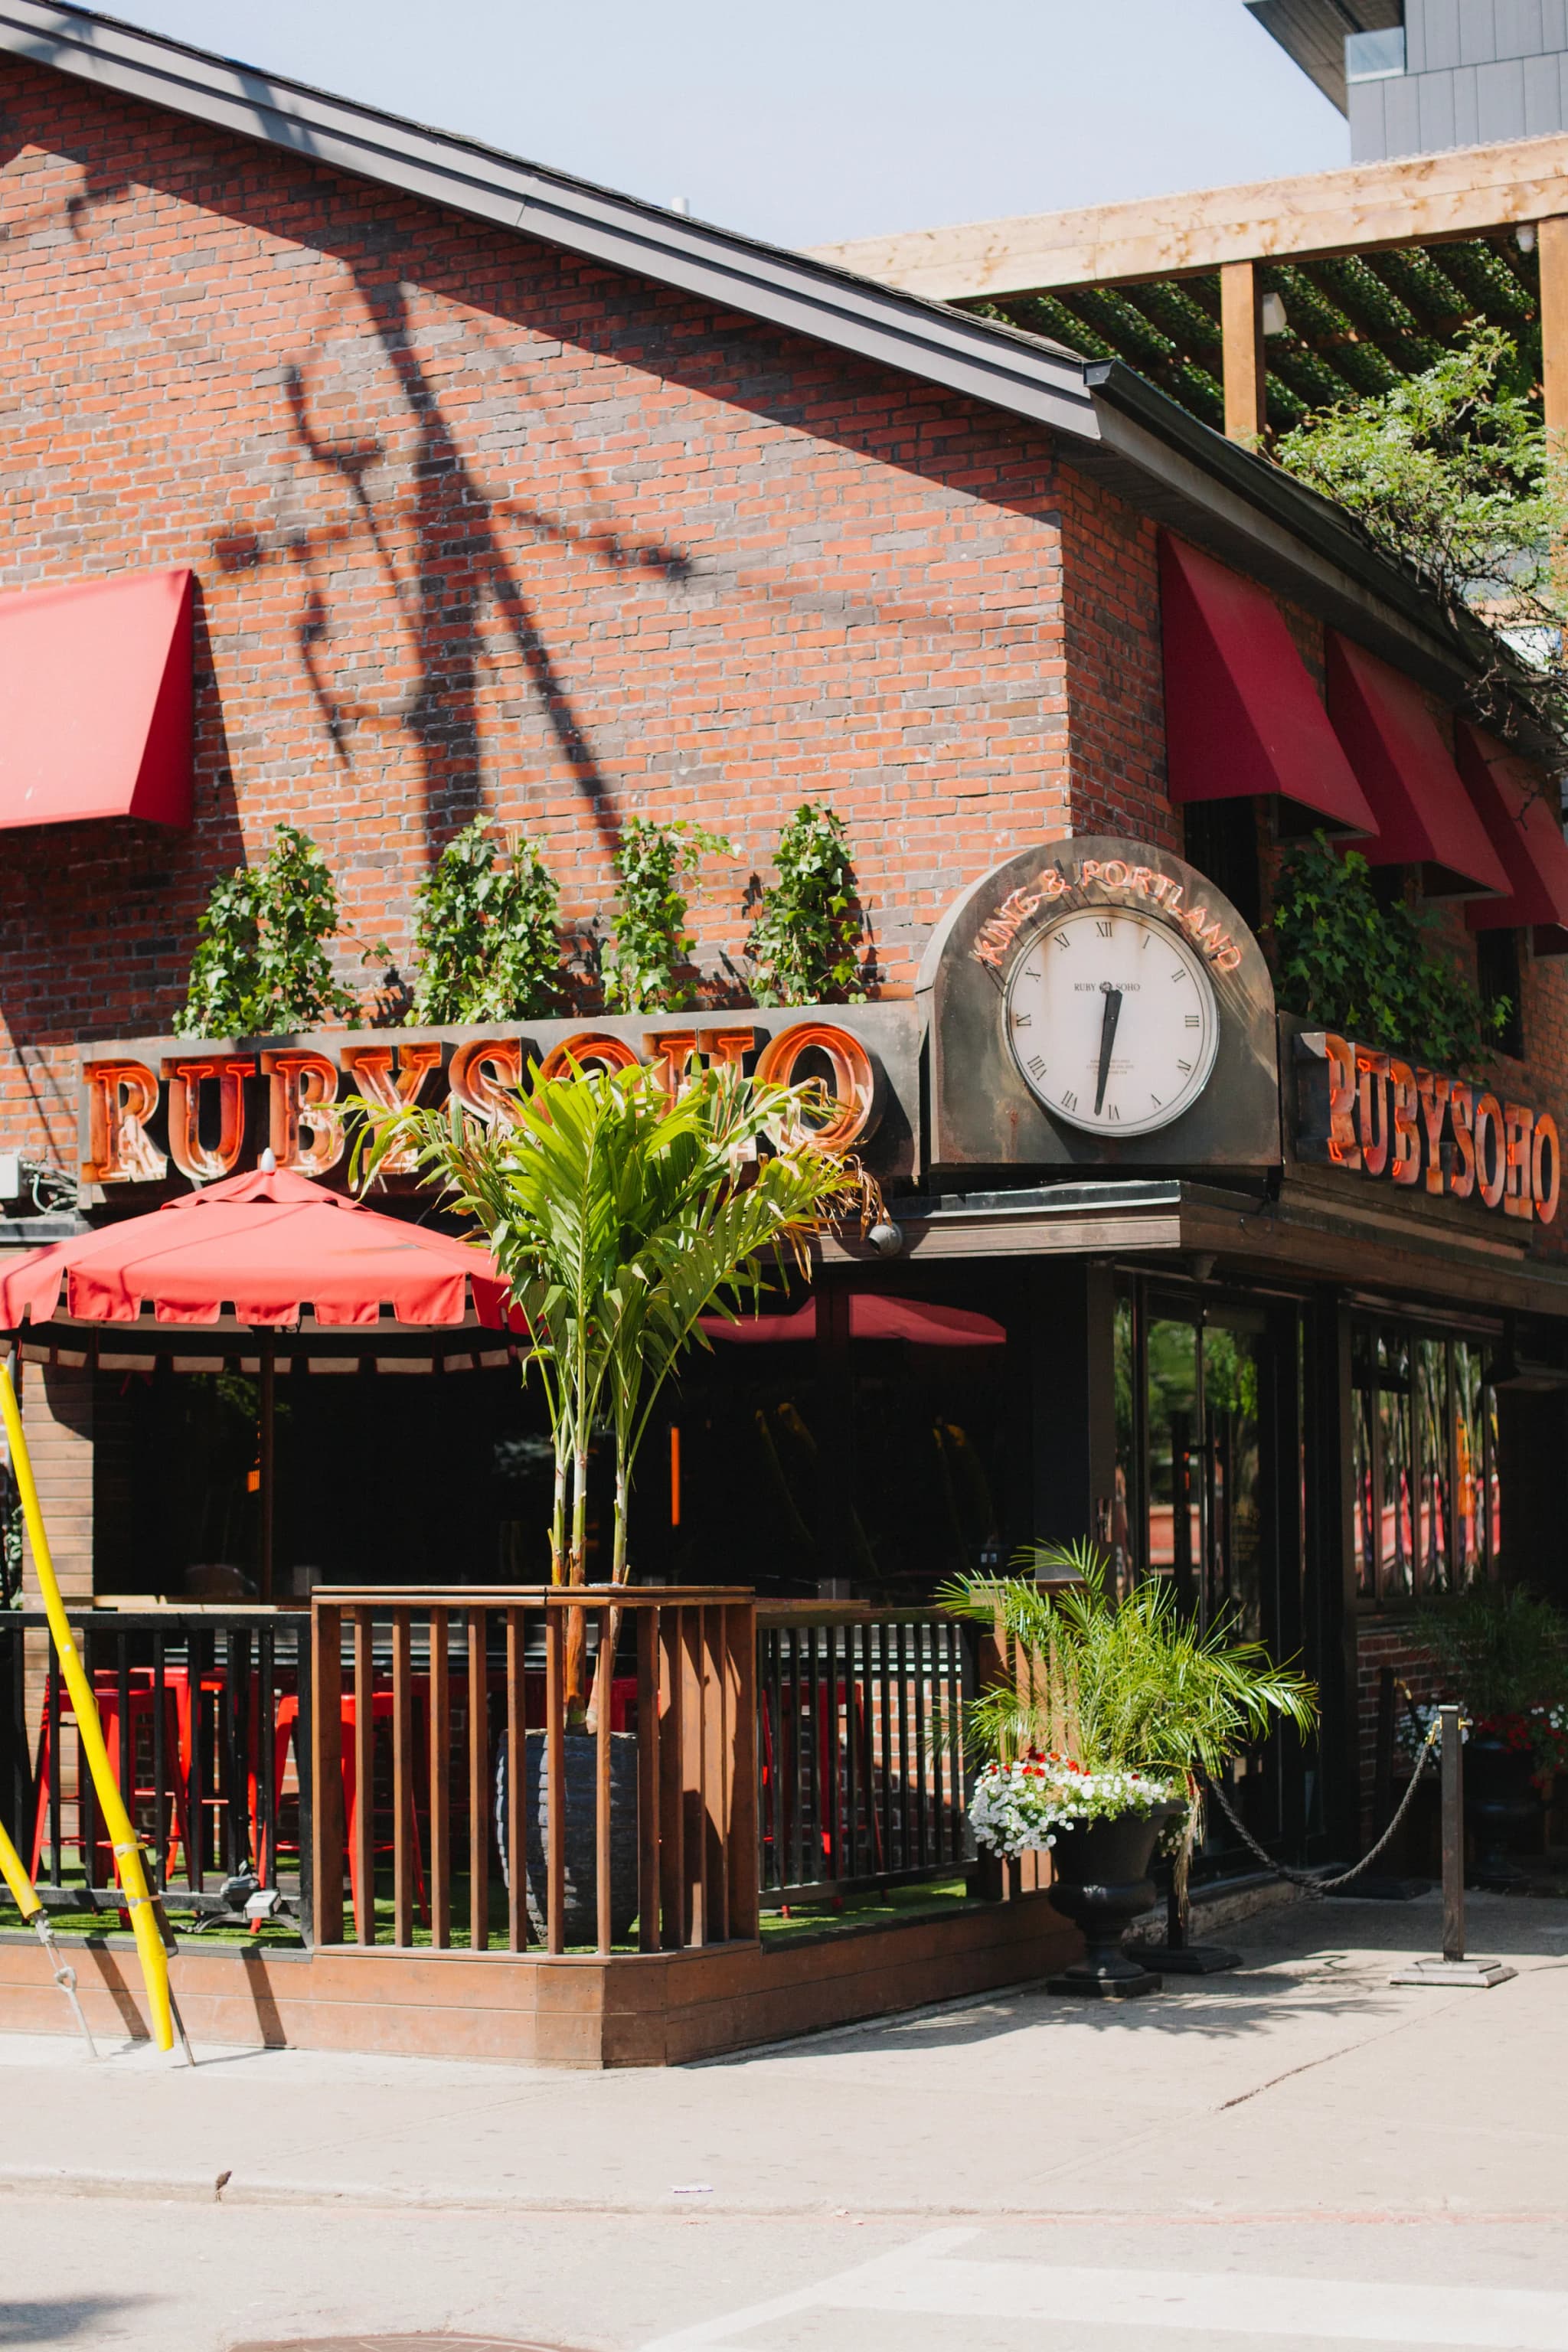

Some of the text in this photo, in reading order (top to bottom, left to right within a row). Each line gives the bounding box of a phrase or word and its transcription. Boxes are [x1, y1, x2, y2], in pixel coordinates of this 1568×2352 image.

[972, 860, 1242, 969] KING & PORTLAND
[1096, 921, 1113, 938] XII
[1053, 932, 1070, 951] XI
[1025, 967, 1041, 982] X
[1171, 969, 1186, 982] II
[1073, 982, 1141, 991] RUBY SOHO
[1184, 1014, 1200, 1027] III
